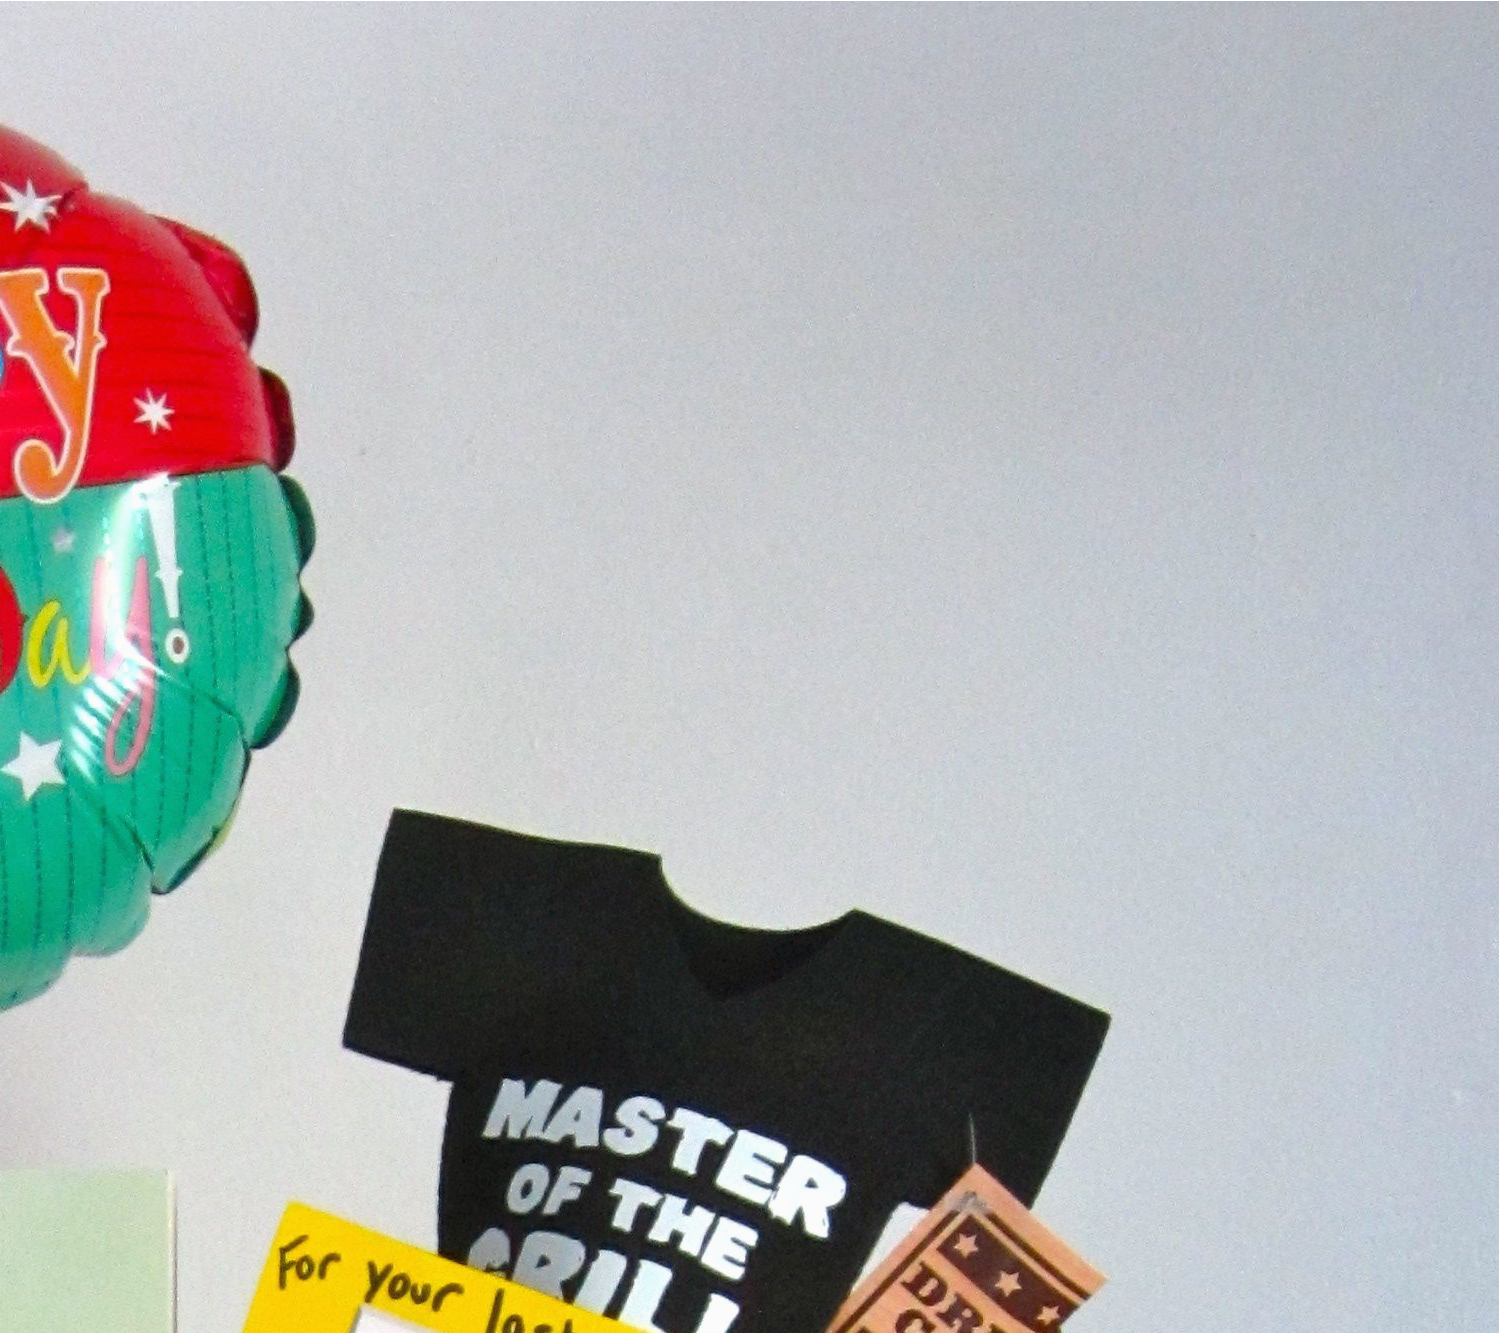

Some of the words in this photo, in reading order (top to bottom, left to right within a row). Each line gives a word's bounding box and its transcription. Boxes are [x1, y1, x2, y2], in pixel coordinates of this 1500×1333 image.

[482, 1078, 847, 1240] MASTER
[276, 1236, 340, 1291] For
[366, 1259, 464, 1311] your
[506, 1163, 594, 1214] OF
[608, 1175, 759, 1283] THE
